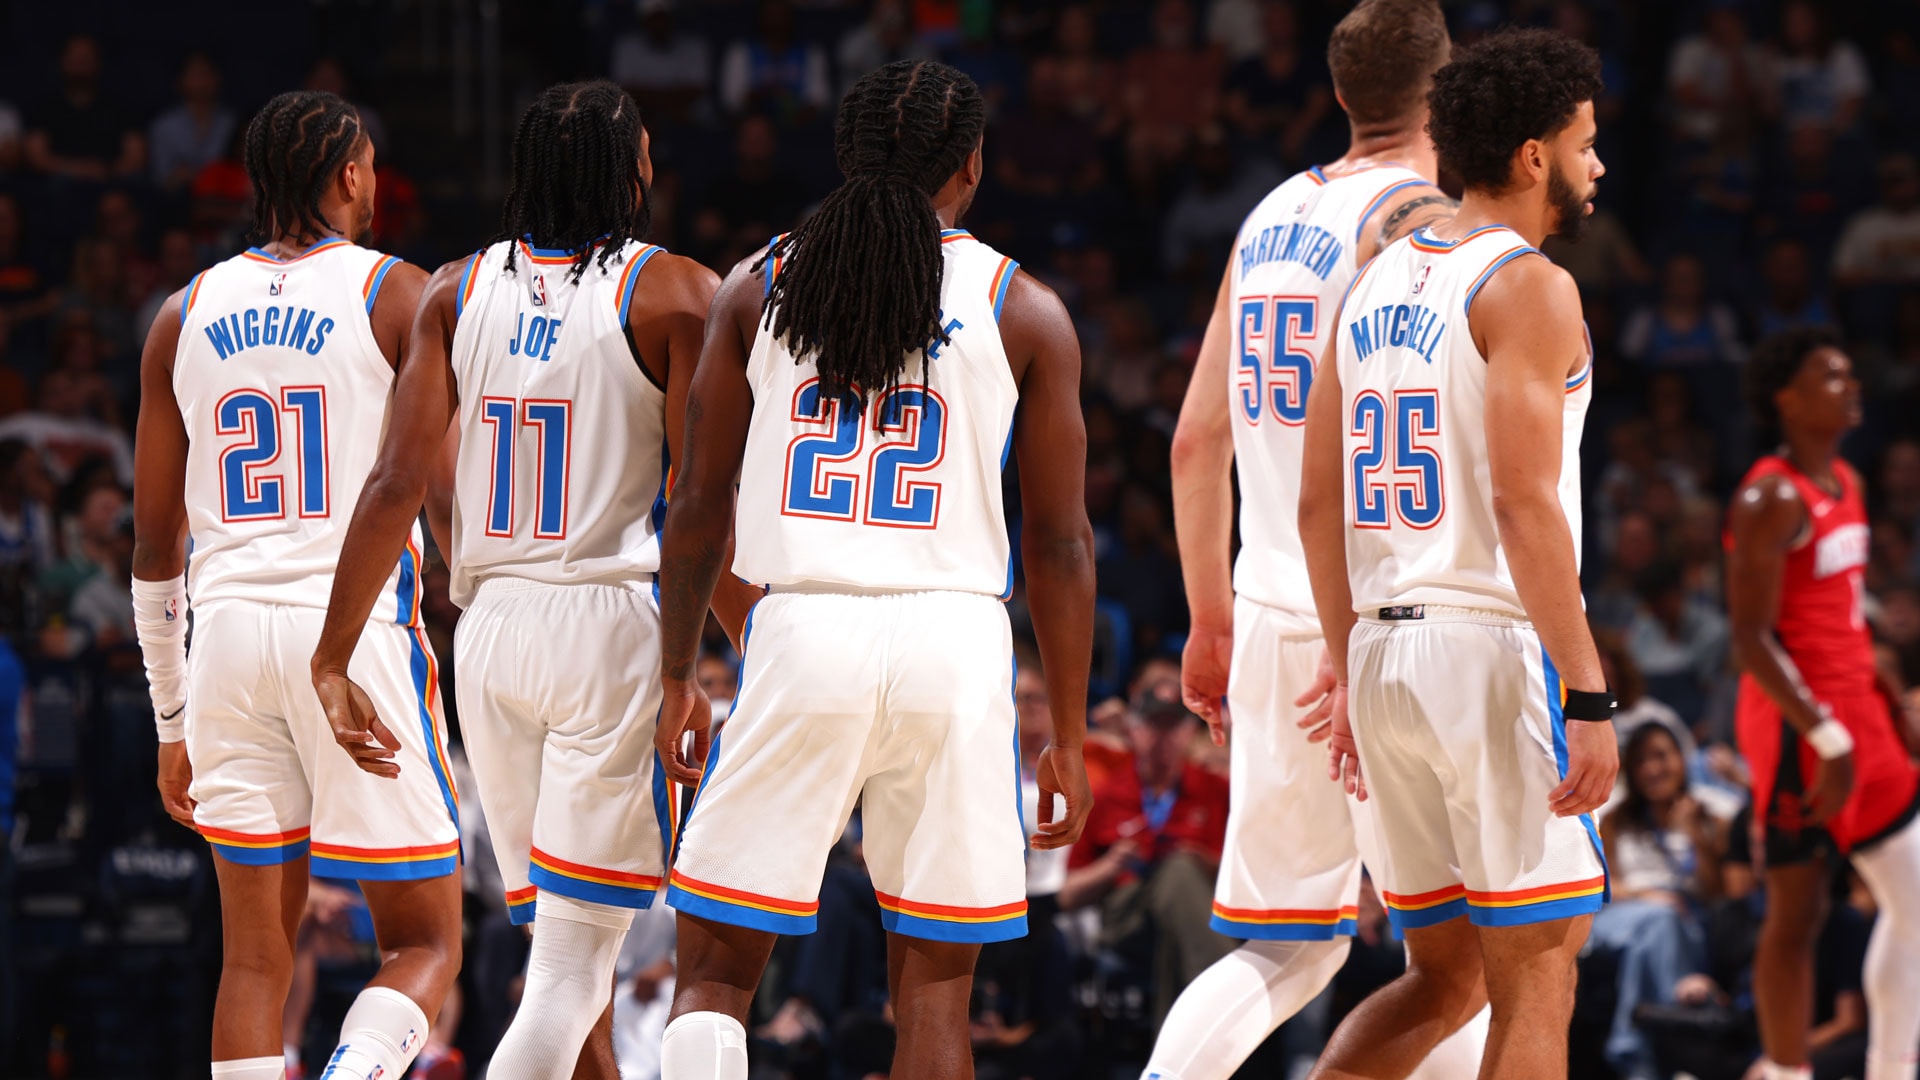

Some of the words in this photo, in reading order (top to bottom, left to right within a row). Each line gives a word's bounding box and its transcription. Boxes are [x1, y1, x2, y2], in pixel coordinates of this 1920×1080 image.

[204, 306, 335, 361] WIGGINS
[509, 312, 562, 361] JOE
[1238, 295, 1318, 427] 55
[1350, 304, 1446, 365] MITCHELL
[214, 385, 329, 523] 21
[482, 396, 572, 540] 11
[780, 375, 948, 529] 22
[1350, 389, 1445, 530] 25
